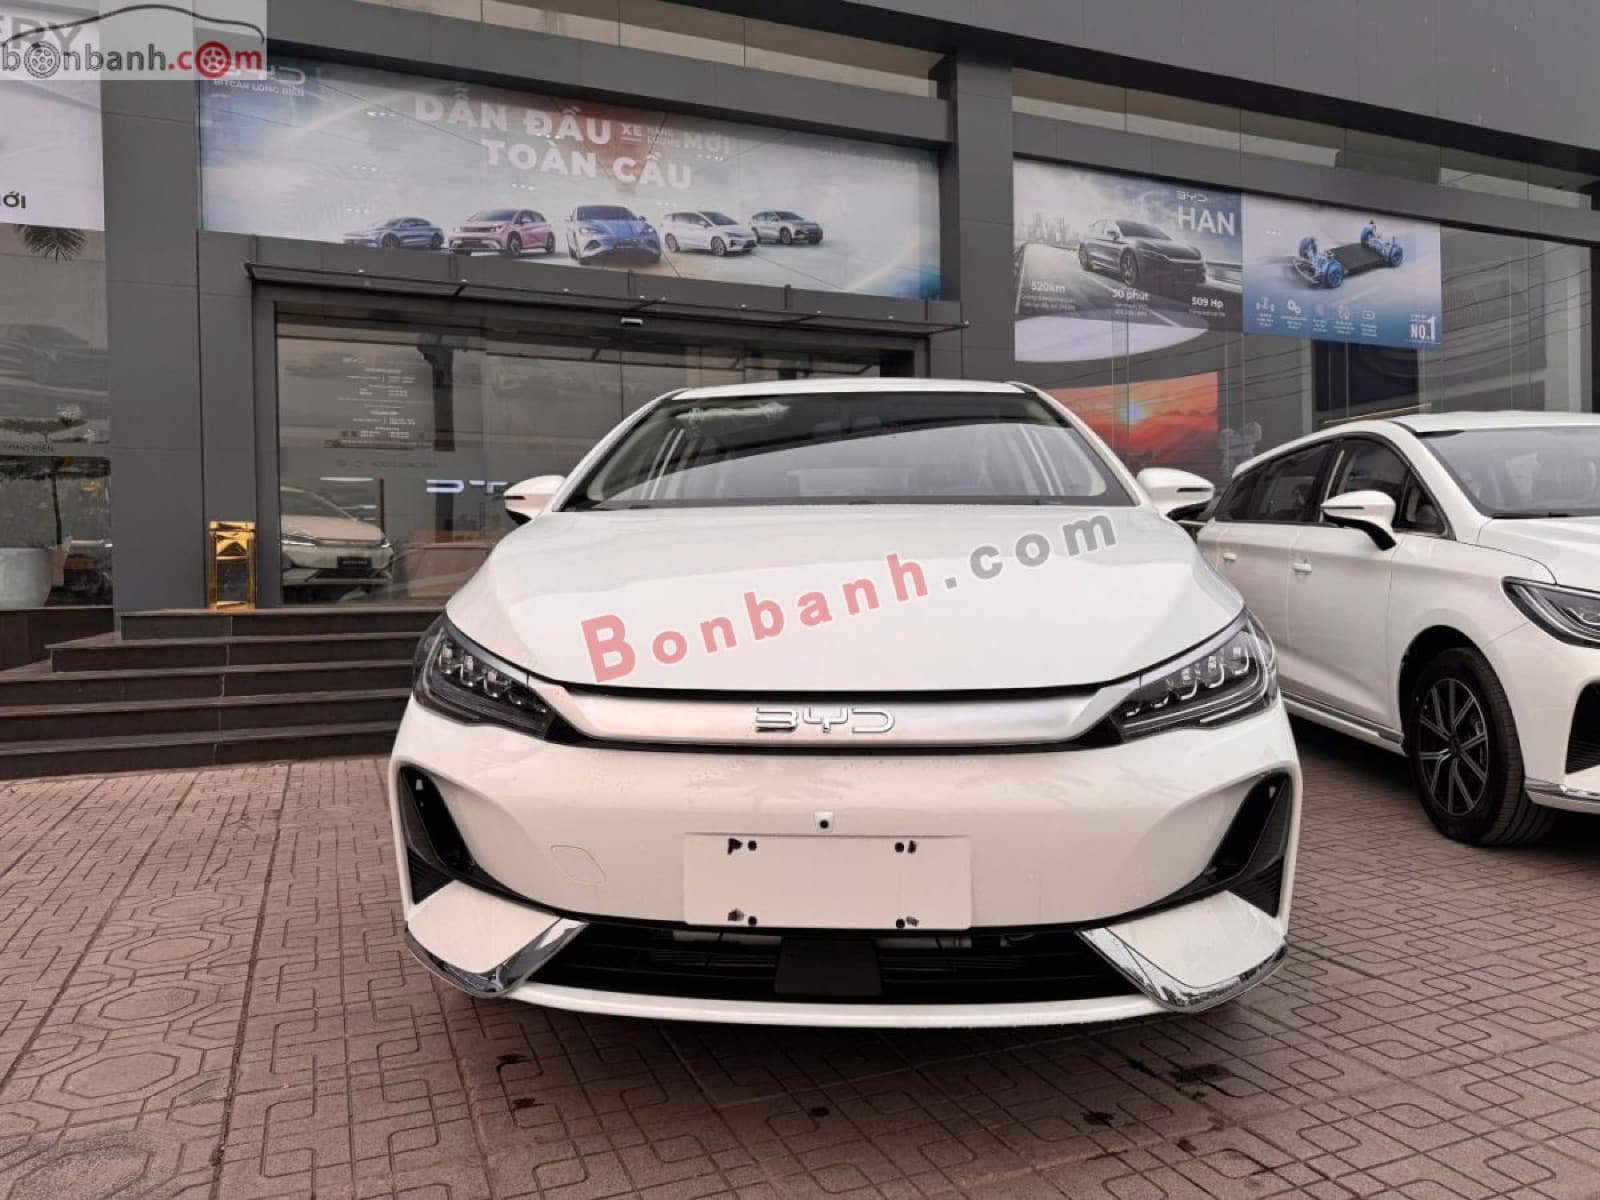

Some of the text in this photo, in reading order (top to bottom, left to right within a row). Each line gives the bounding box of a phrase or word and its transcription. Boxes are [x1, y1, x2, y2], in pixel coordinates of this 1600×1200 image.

[0, 15, 82, 54] RY
[416, 87, 508, 132] DẪN
[523, 106, 611, 145] ĐẦU
[621, 123, 643, 137] XE
[480, 138, 692, 190] TOÀN CẦU
[1178, 205, 1235, 236] HAN
[1191, 296, 1209, 307] 509
[1409, 315, 1437, 341] NO.1
[754, 706, 895, 734] BYD
